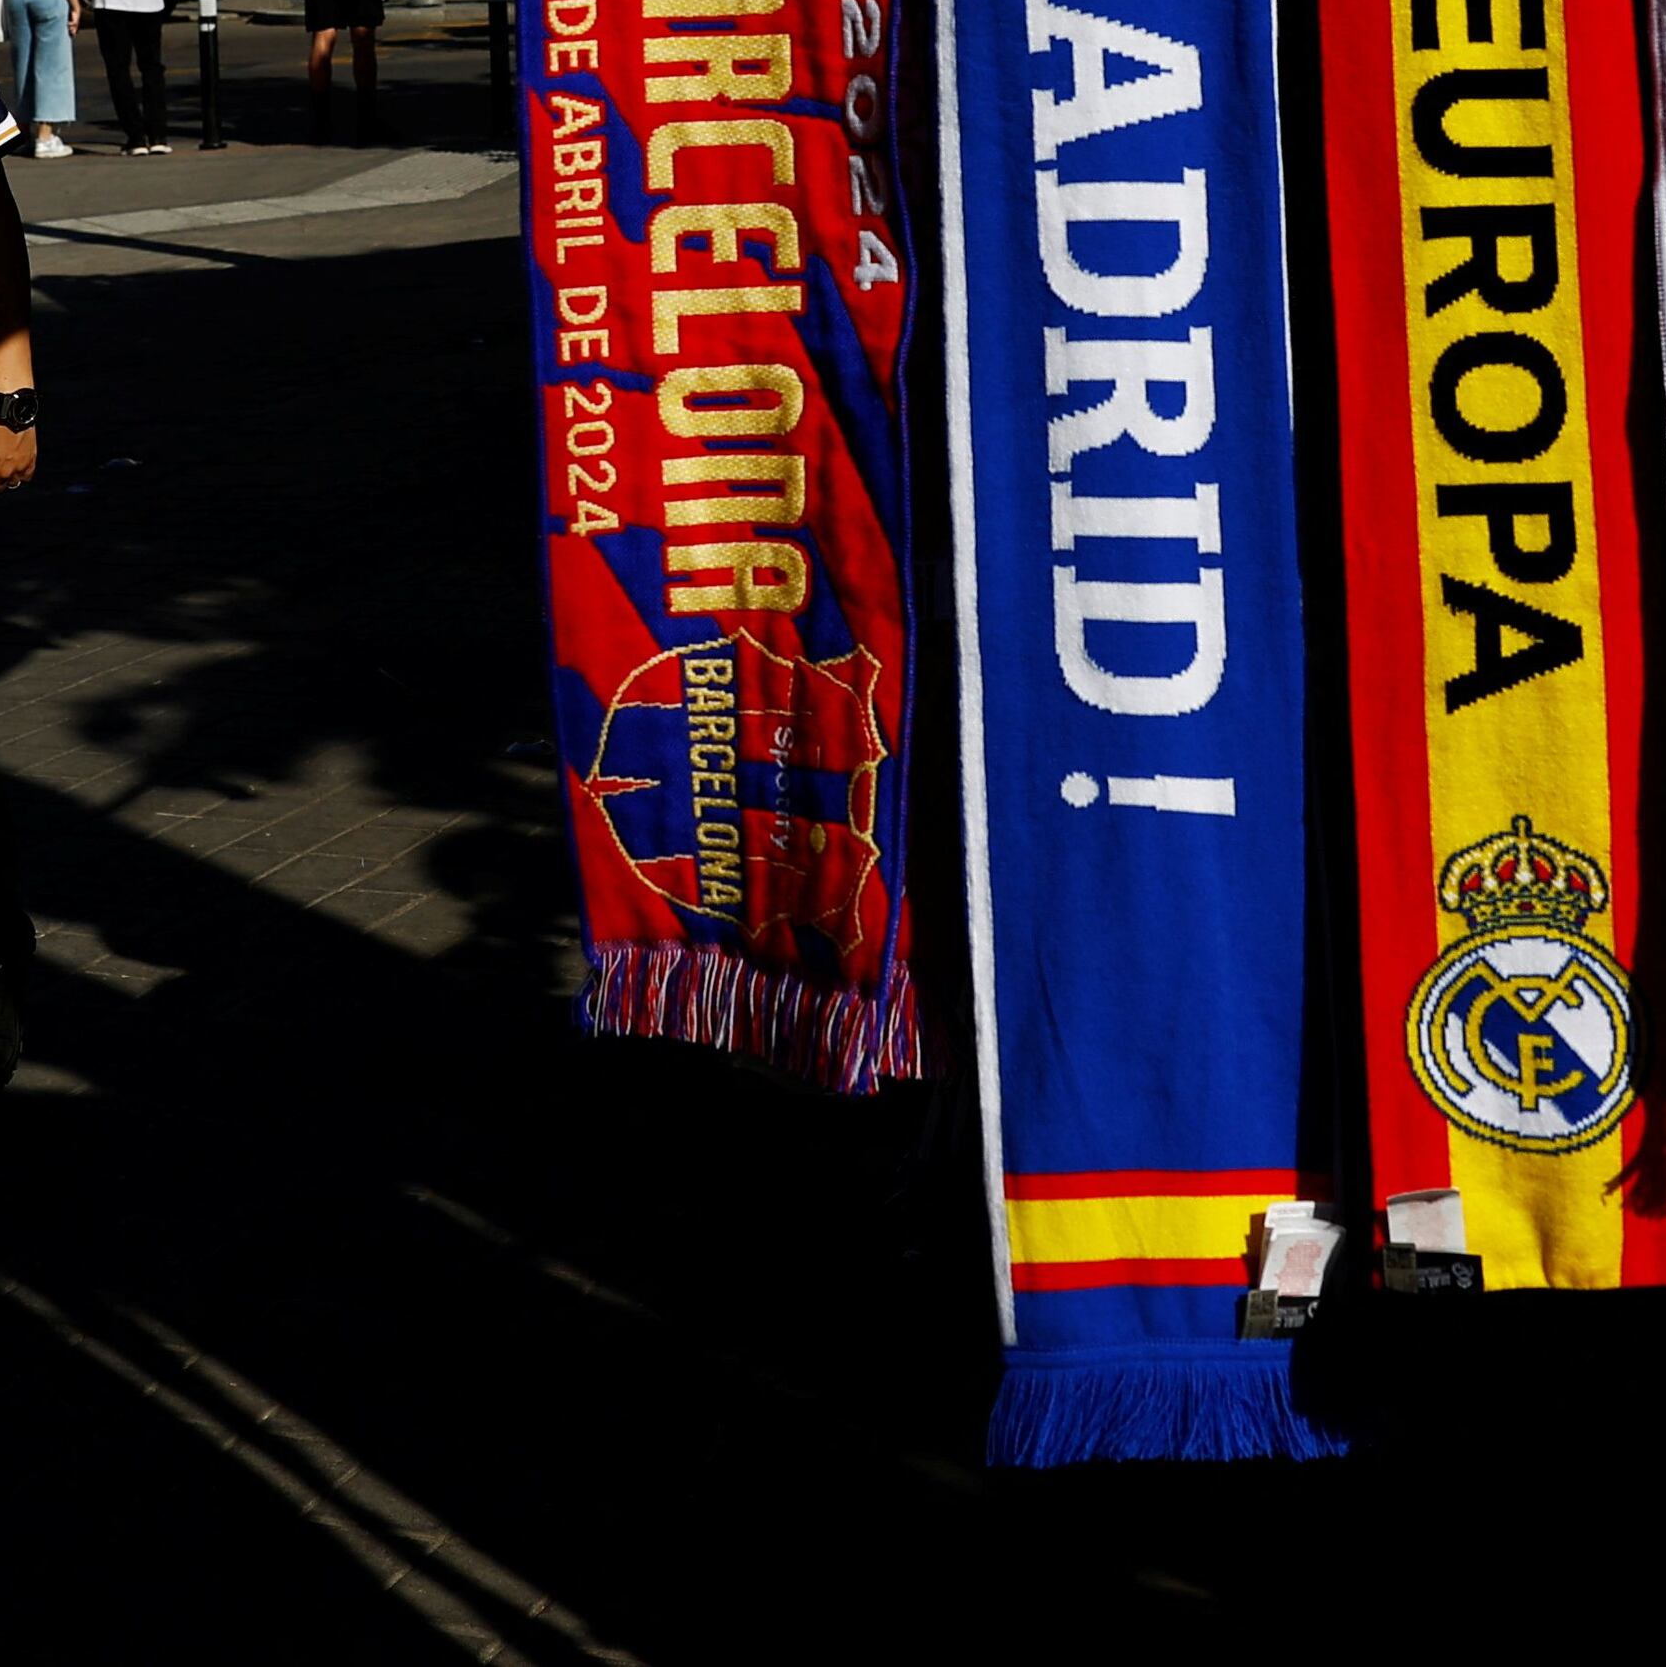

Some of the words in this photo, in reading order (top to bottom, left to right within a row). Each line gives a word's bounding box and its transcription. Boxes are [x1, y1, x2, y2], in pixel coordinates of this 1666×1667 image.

[551, 96, 606, 265] ABRIL
[555, 285, 609, 364] DE
[562, 383, 621, 537] 2024
[683, 655, 744, 908] BARCELONA
